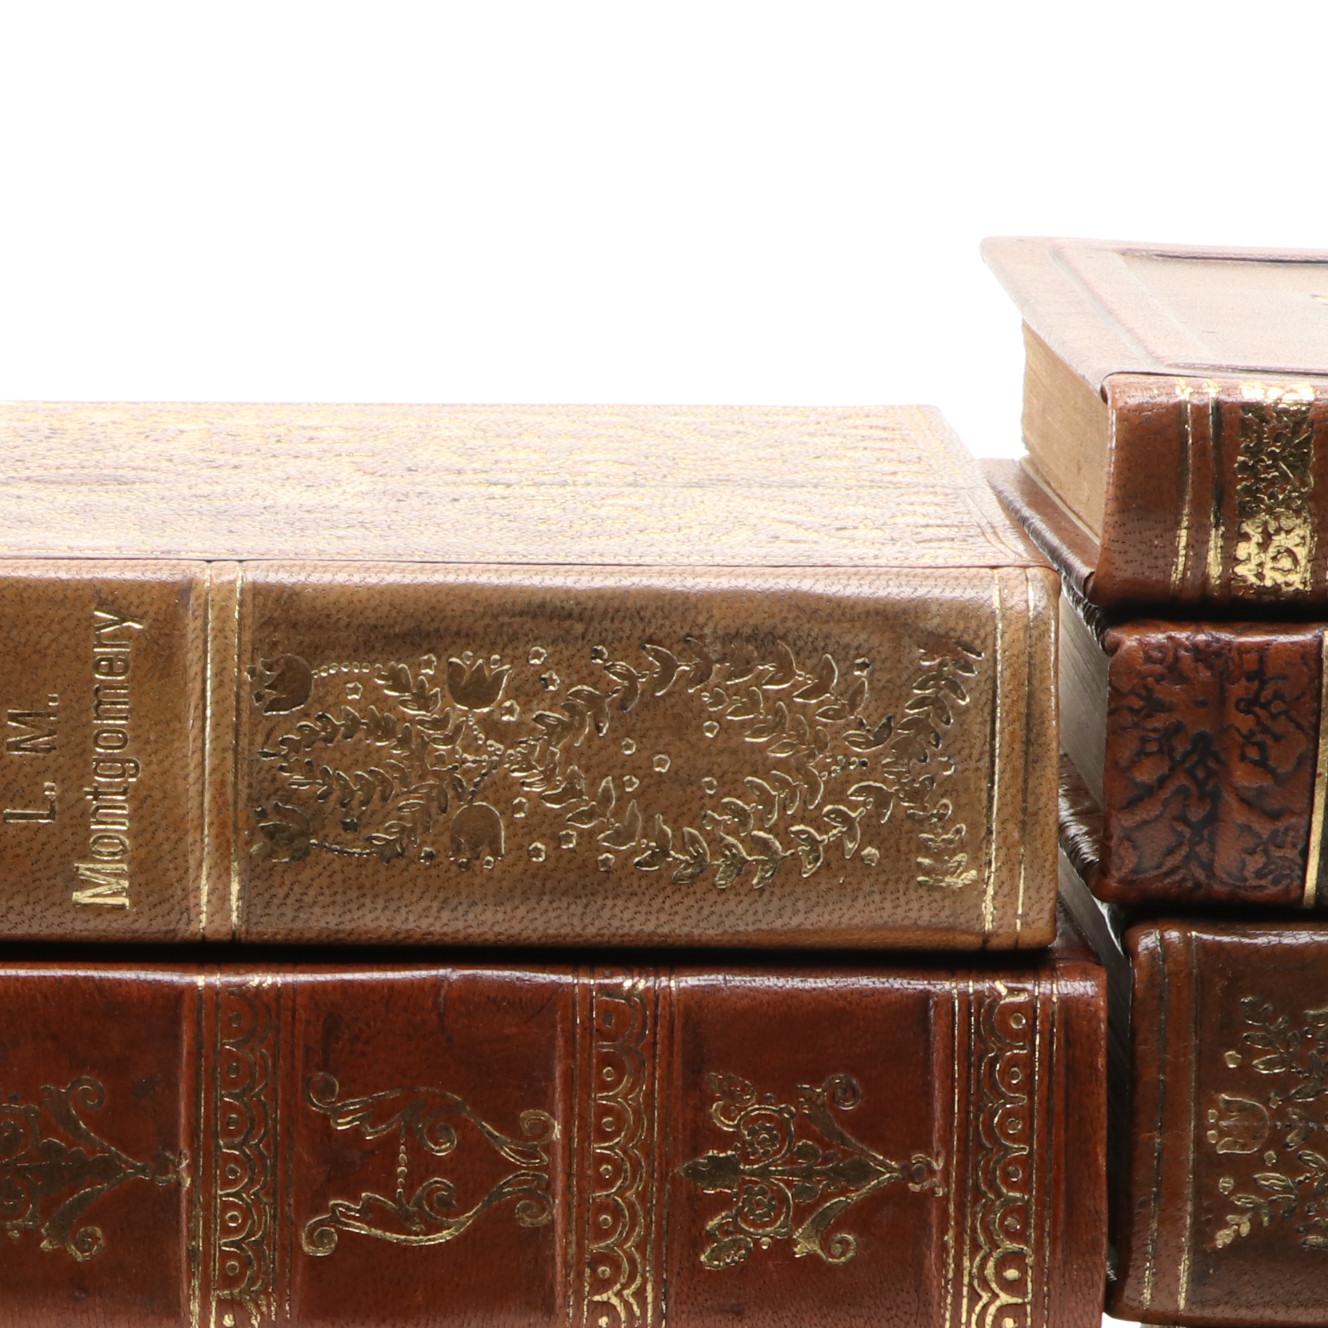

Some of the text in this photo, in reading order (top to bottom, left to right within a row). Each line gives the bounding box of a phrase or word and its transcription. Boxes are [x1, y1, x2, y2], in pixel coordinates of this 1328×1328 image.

[3, 693, 60, 824] L. M.
[73, 608, 144, 910] Montgomery
